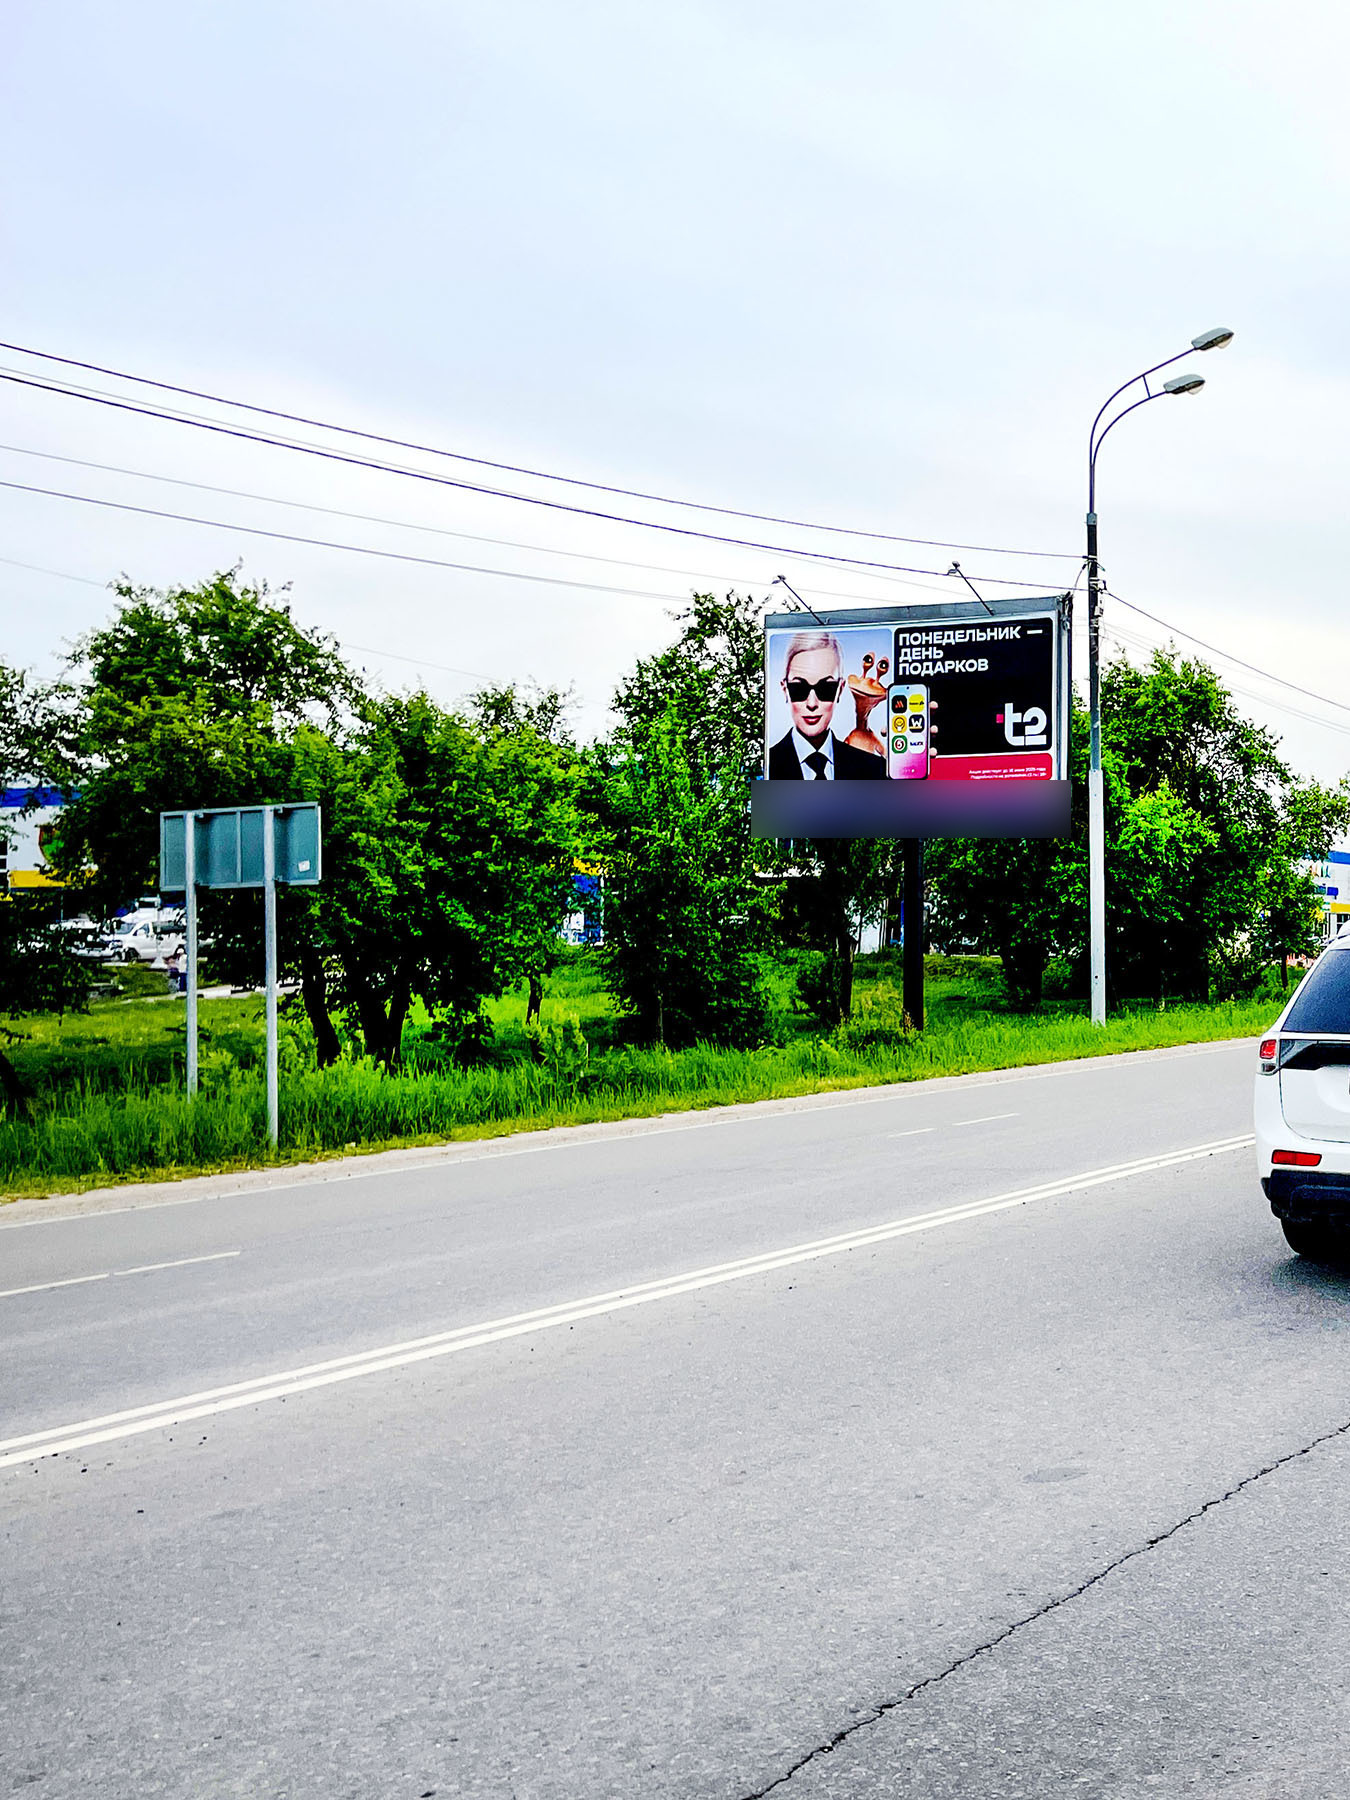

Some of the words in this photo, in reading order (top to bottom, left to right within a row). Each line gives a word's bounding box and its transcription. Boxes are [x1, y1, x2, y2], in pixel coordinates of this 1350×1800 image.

[899, 626, 1022, 646] ПОНЕДЕЛЬНИК
[899, 646, 944, 662] ДЕНЬ
[898, 658, 989, 677] ПОДАРКОВ
[1004, 702, 1047, 746] t2
